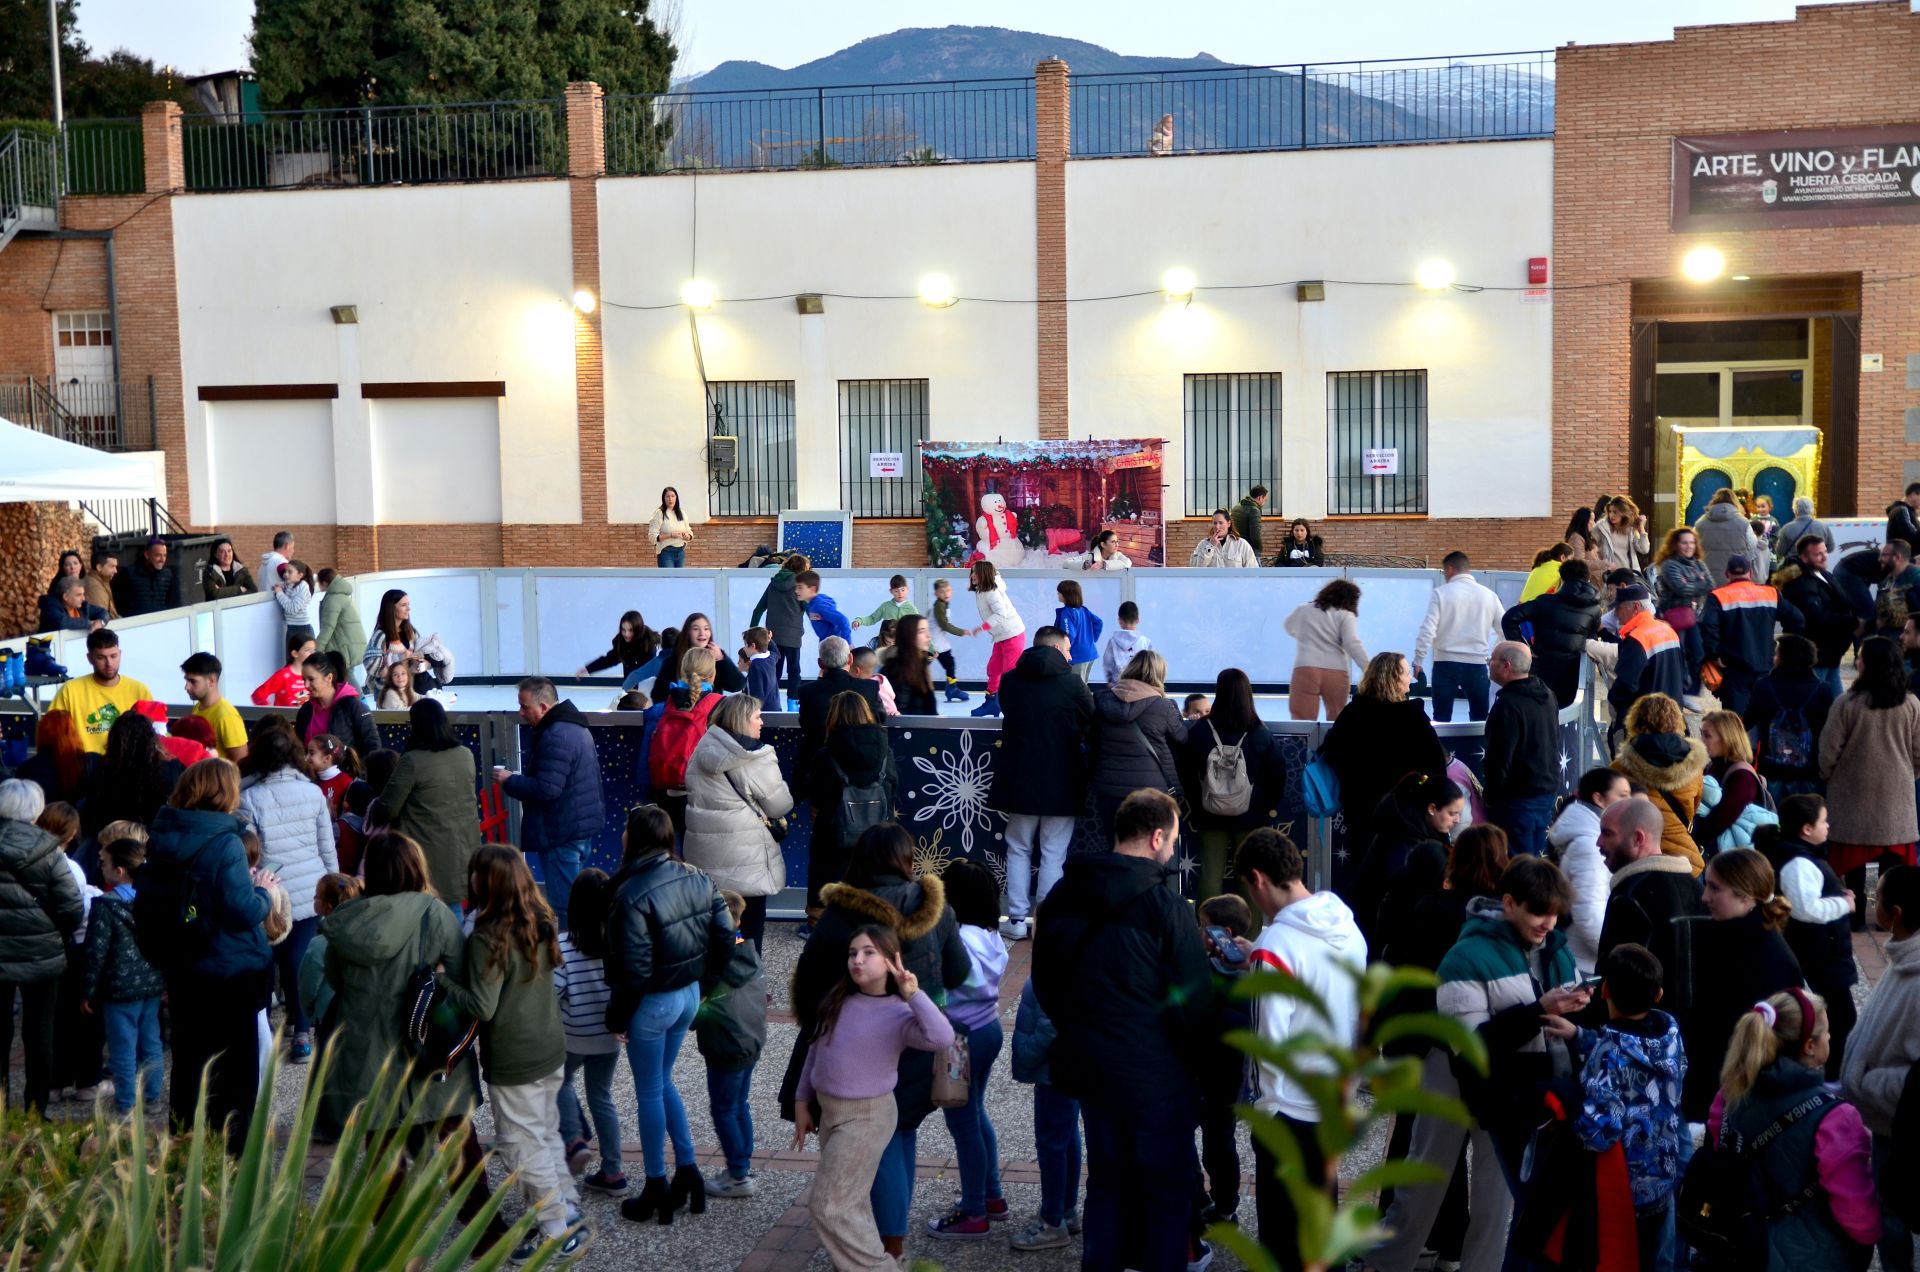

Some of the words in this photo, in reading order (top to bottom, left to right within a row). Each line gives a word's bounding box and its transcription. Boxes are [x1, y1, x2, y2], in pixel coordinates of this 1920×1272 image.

[1693, 154, 1763, 176] ARTE,
[1770, 150, 1835, 173] VINO
[1841, 155, 1856, 174] y
[1790, 174, 1840, 187] HUERTA
[1842, 171, 1901, 185] CERCADA
[1794, 185, 1844, 194] AYUNTAMIENTO
[1845, 184, 1853, 192] DE
[1116, 453, 1160, 467] CHRISTMAS
[1784, 1095, 1824, 1124] BIMBA
[1751, 1120, 1783, 1151] BIMBA
